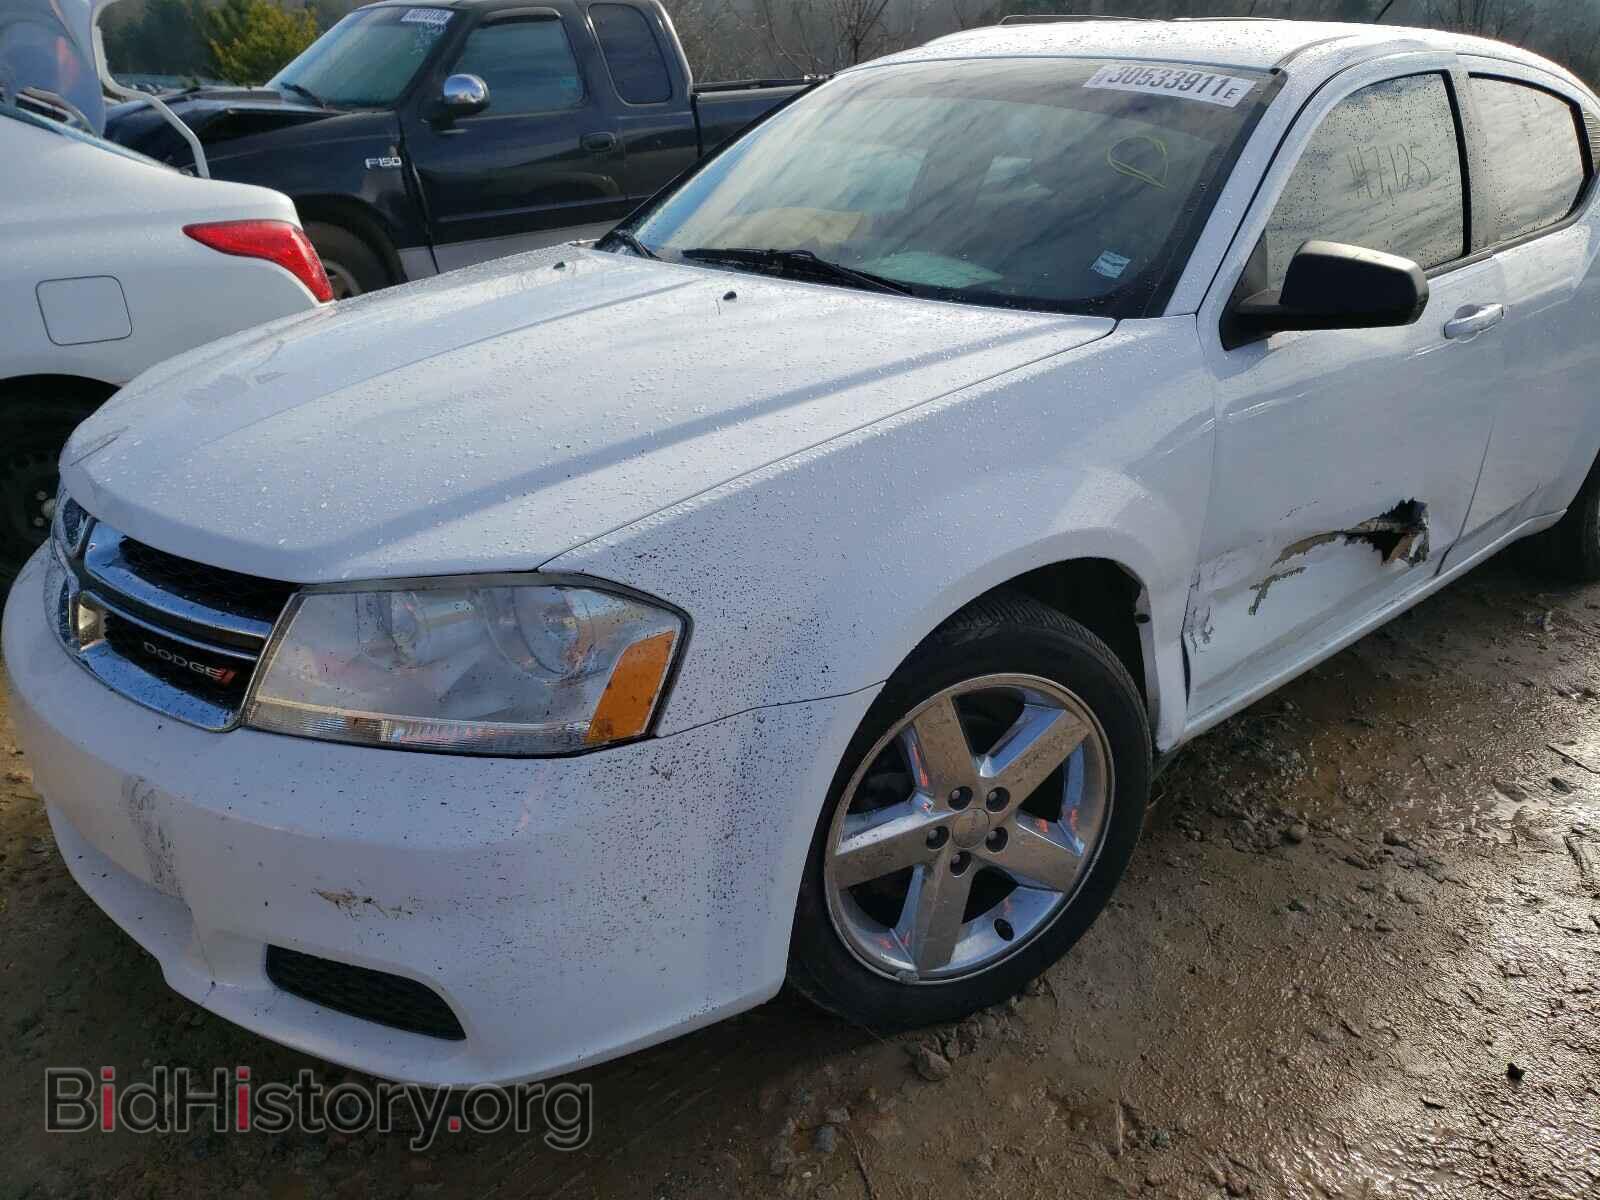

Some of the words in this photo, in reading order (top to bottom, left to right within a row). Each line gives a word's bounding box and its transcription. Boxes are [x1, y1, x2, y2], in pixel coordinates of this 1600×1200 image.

[1107, 65, 1231, 97] 30533911
[365, 156, 402, 169] F150
[143, 641, 225, 680] DODGE
